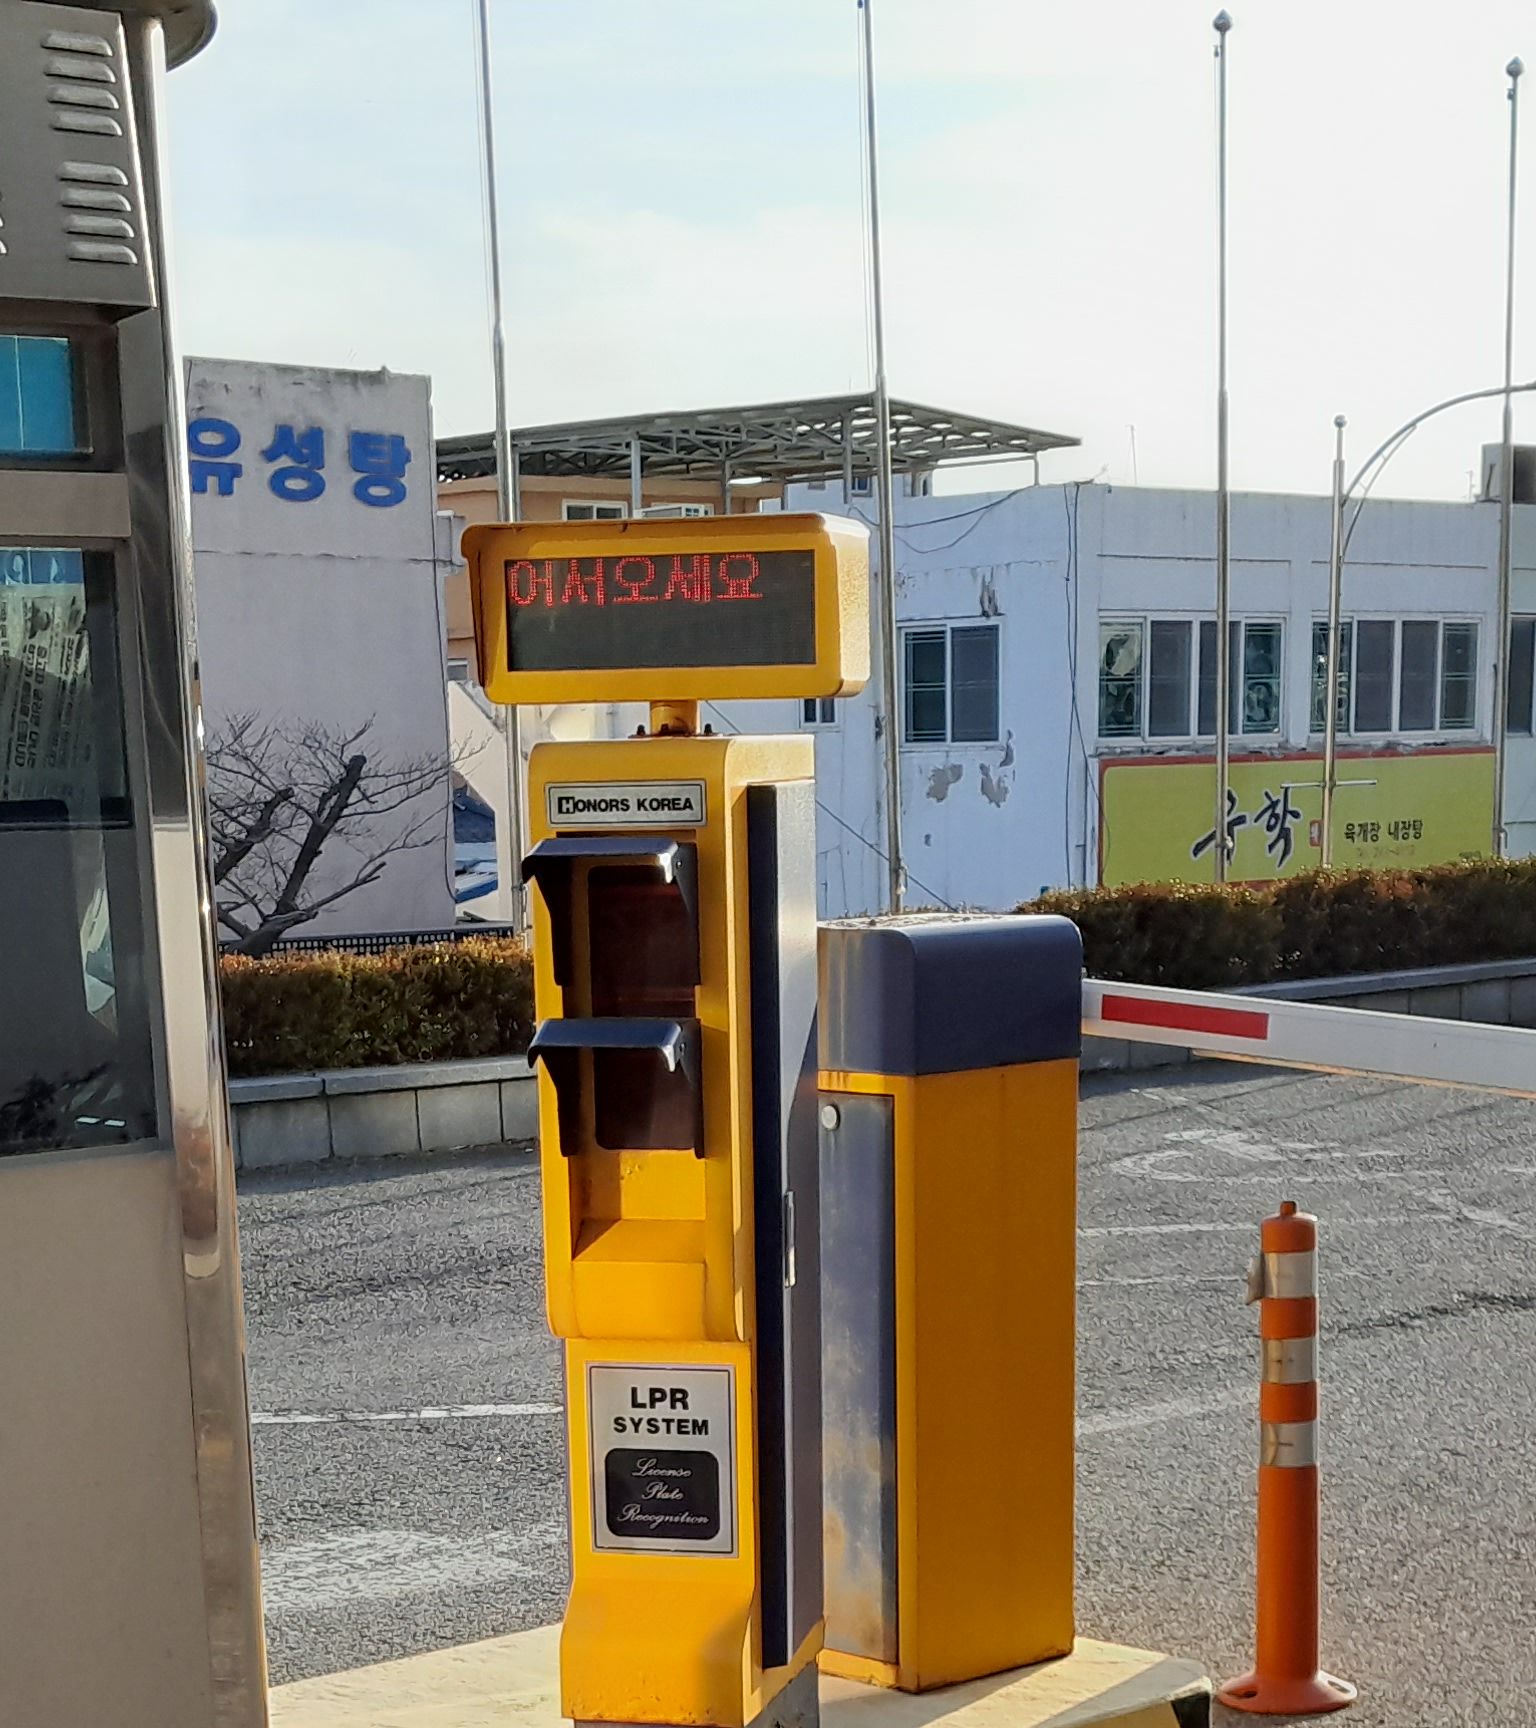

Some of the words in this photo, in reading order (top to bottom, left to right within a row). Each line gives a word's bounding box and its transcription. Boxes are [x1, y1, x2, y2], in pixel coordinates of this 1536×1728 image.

[189, 418, 412, 507] 유성탕
[509, 553, 763, 607] 어서오세요
[557, 796, 631, 814] HONORS
[637, 797, 694, 812] KOREA
[1344, 822, 1381, 843] 육개장
[1387, 819, 1423, 841] 내장탕
[630, 1386, 690, 1411] LPR
[613, 1416, 710, 1436] SYSTEM
[631, 1457, 693, 1478] License
[641, 1481, 685, 1501] Plate
[617, 1503, 710, 1530] Recognition
